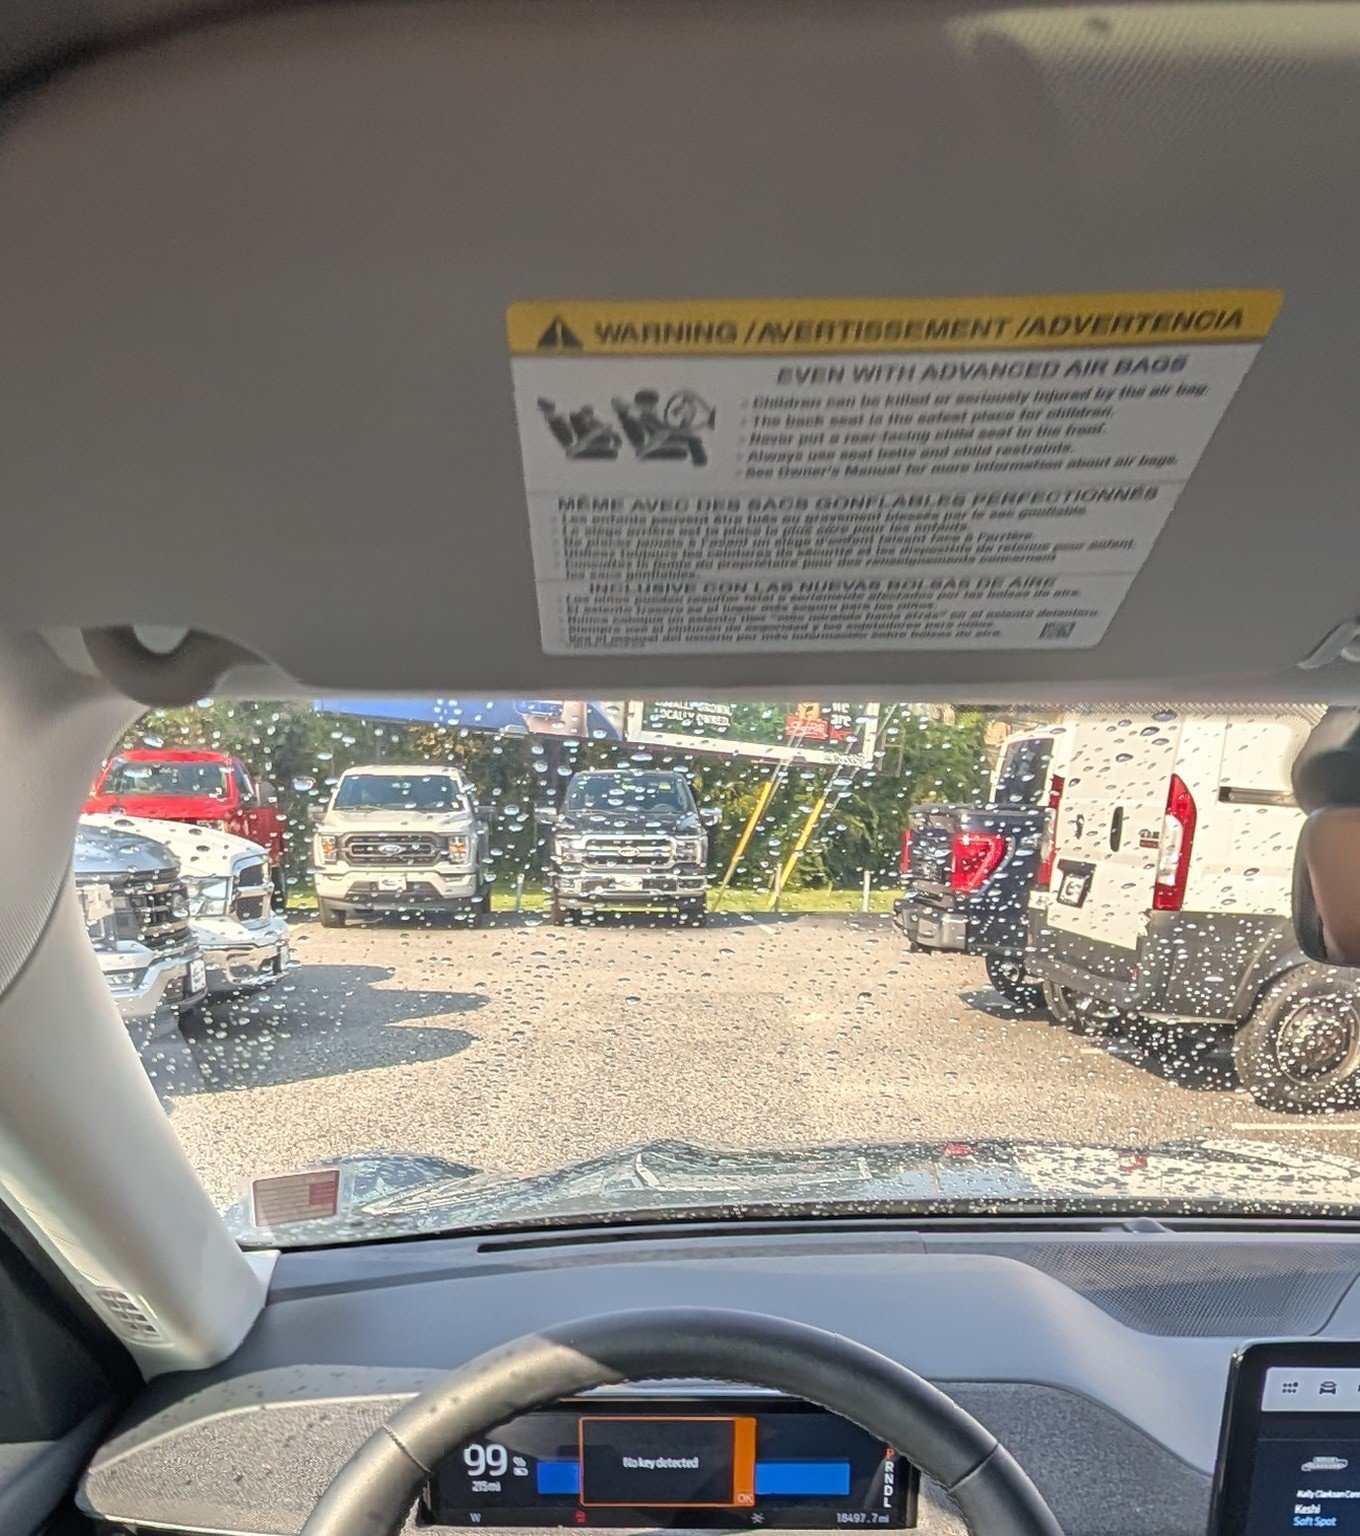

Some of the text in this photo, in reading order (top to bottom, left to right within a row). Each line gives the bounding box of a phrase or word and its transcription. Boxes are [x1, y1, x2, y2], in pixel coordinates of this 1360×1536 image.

[594, 320, 738, 345] WARNING
[777, 354, 1189, 385] EVEN WITH ADVANCED AIR BAGS
[463, 1443, 508, 1477] 99
[885, 1461, 894, 1472] R
[884, 1473, 894, 1484] N
[884, 1485, 893, 1496] D
[883, 1498, 892, 1508] L
[1293, 1516, 1337, 1528] Soft Spot
